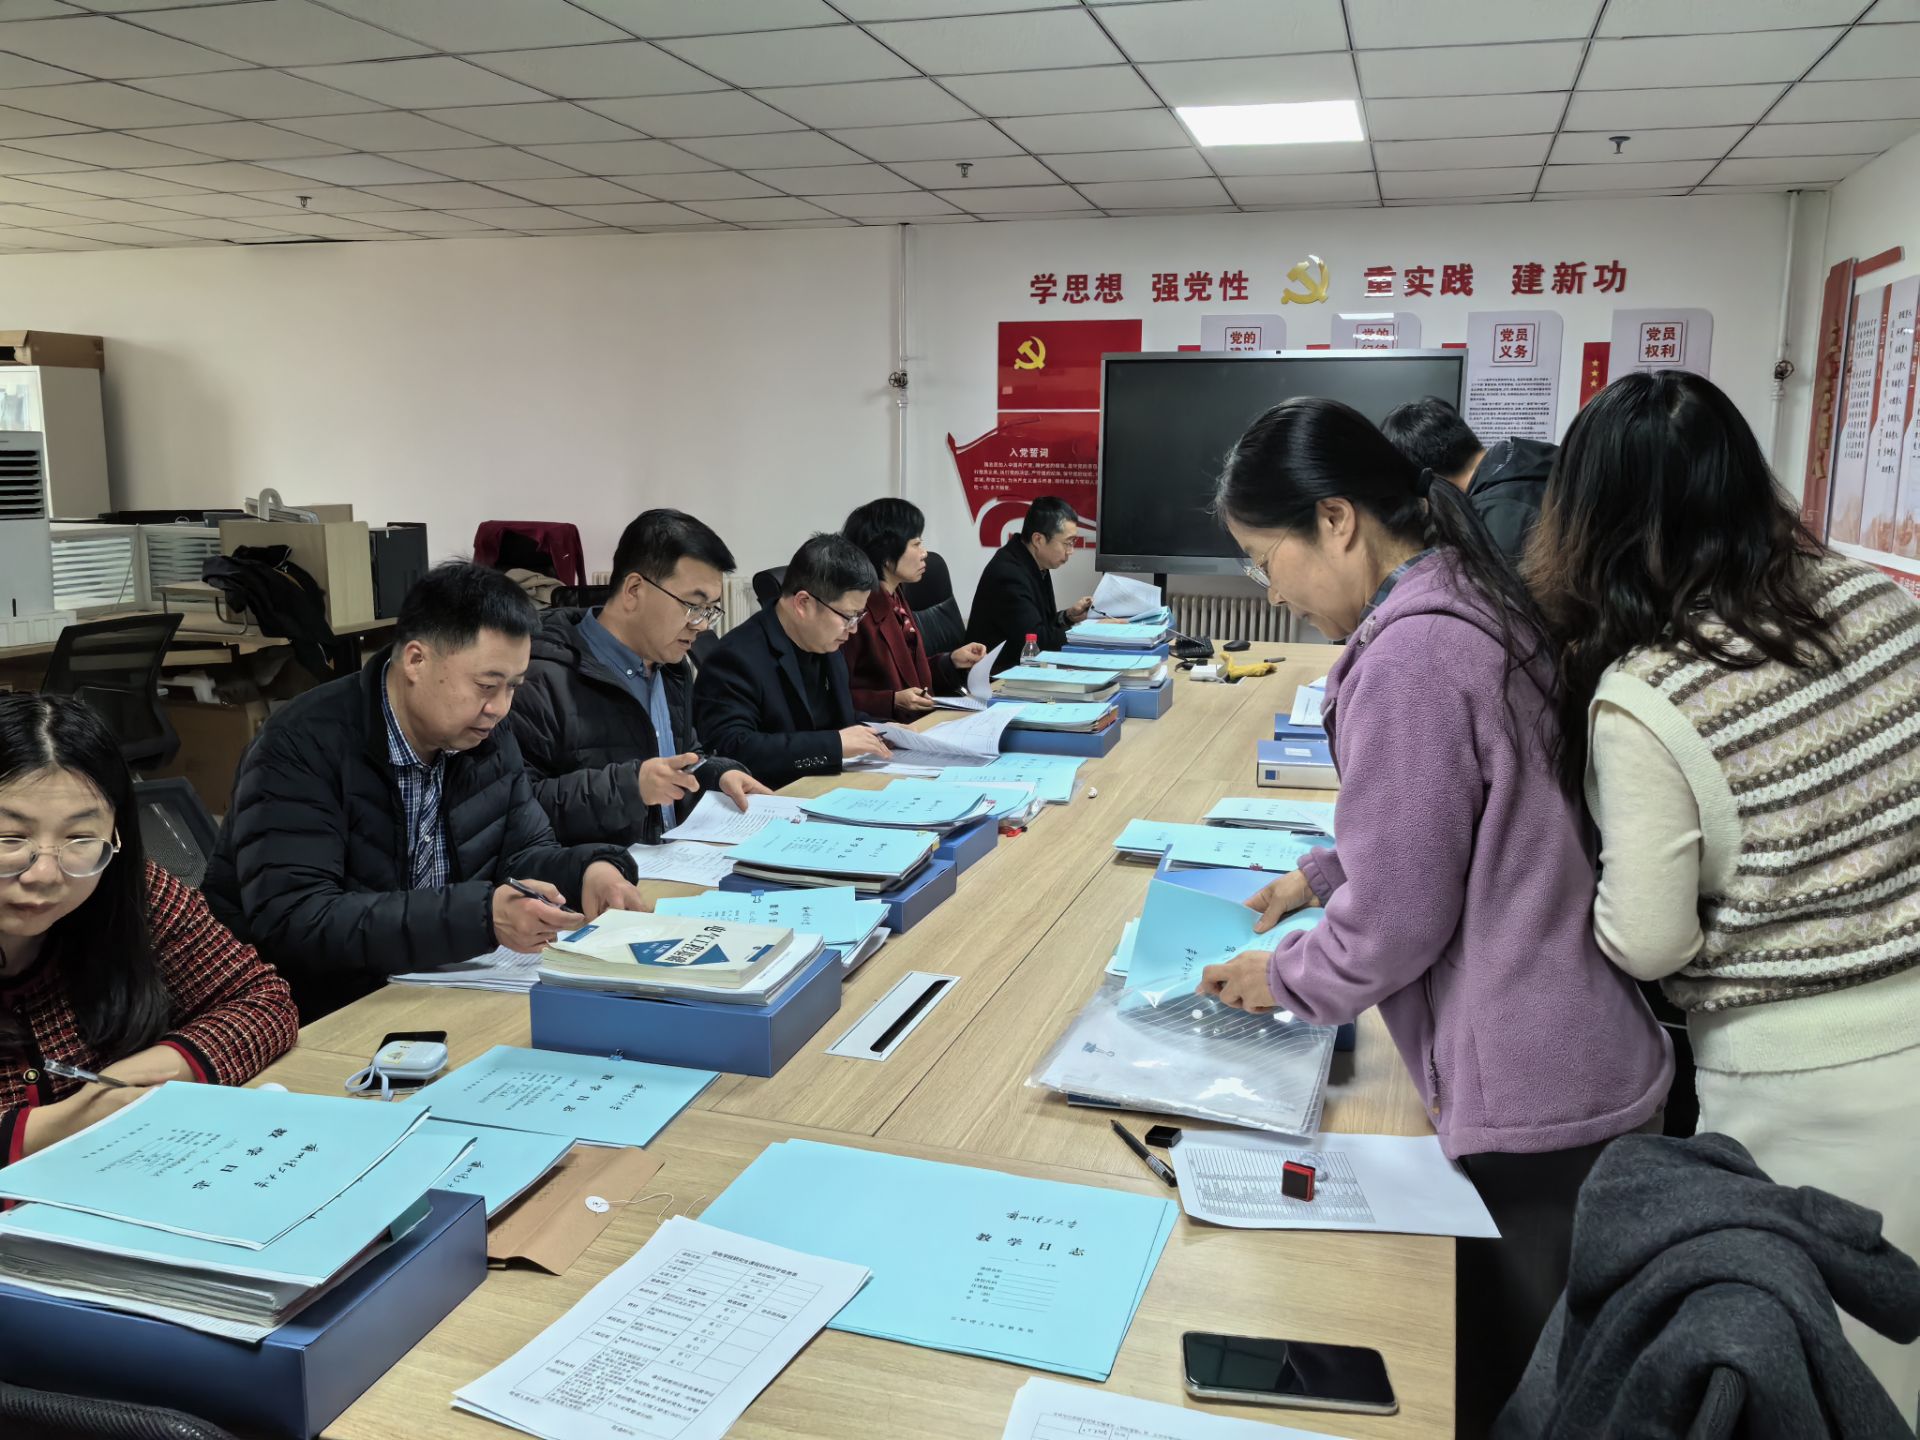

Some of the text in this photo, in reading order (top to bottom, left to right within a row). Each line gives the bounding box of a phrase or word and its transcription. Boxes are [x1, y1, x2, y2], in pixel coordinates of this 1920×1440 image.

[1030, 260, 1628, 304] 学思想 强党性 重实践 建新功
[1230, 330, 1256, 345] 党的
[1500, 327, 1528, 342] 党员
[1646, 326, 1676, 341] 党员
[1499, 344, 1528, 359] 义务
[1644, 343, 1676, 358] 权利
[1009, 447, 1049, 458] 入党誓词
[192, 1127, 288, 1190] 教学日志
[976, 1232, 1085, 1257] 教学日志
